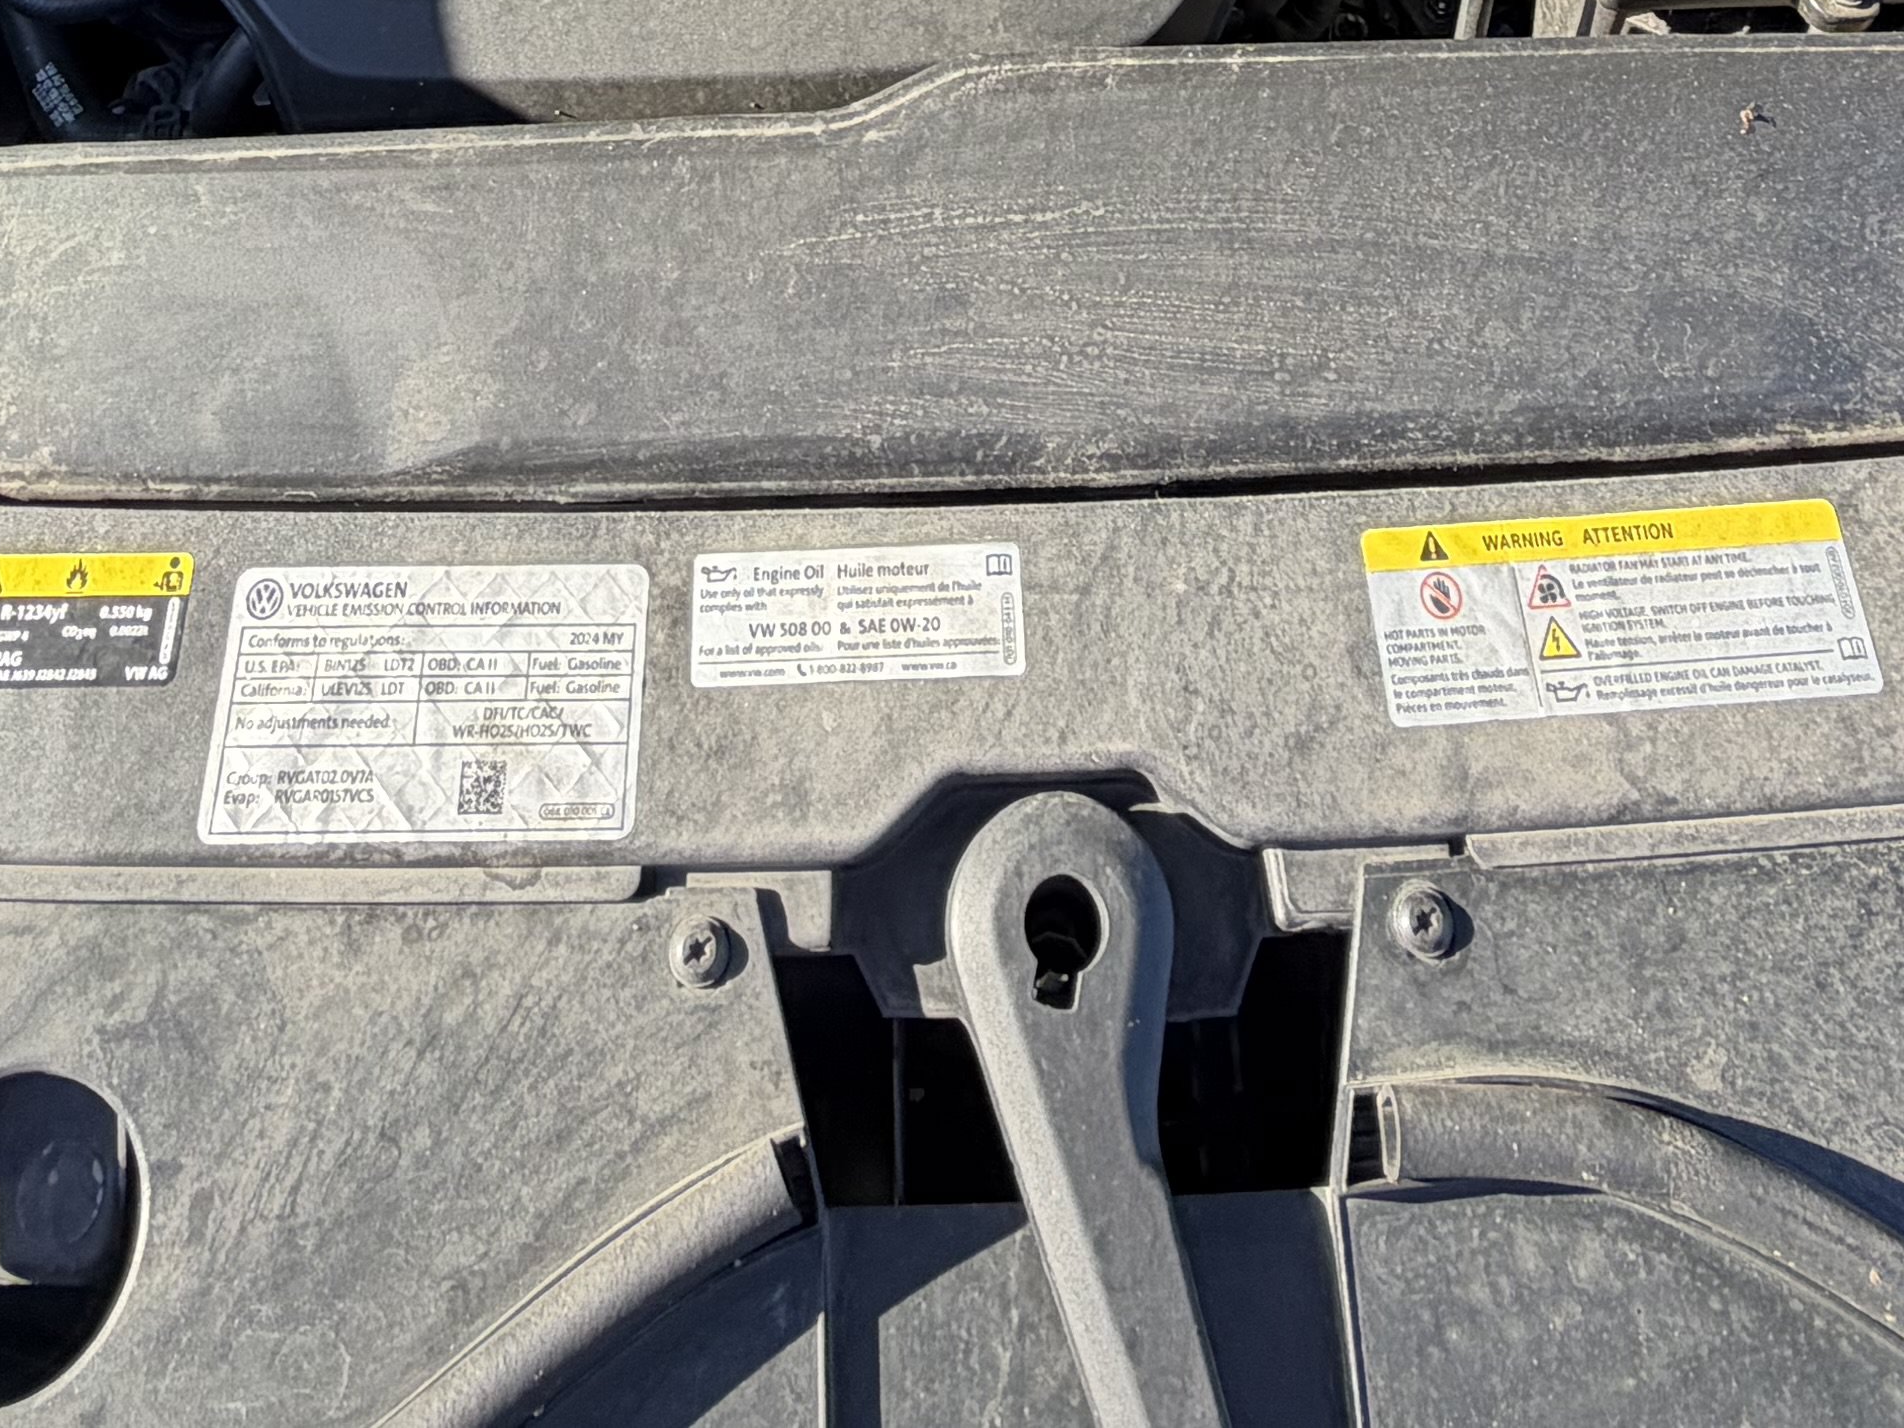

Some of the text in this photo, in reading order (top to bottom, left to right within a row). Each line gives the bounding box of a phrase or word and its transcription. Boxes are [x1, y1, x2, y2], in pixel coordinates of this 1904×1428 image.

[1482, 522, 1674, 551] WARNING ATTENTION
[837, 562, 929, 579] Huile moteur
[1569, 555, 1724, 574] RADIATOR FAN MAY START AT ANY
[753, 564, 824, 584] Engine Oil
[1573, 563, 1821, 590] Le ventilateur de radiateur peut tout
[289, 581, 408, 599] VOLKSWAGEN
[700, 584, 824, 601] Use only oil that expressly
[837, 585, 873, 596] Utilisez
[876, 582, 935, 596] uniquement
[937, 582, 950, 592] de
[287, 601, 562, 617] VEHICLE EMISSION CONTROL INFORMATION
[700, 601, 767, 615] complies with
[837, 599, 852, 612] qui
[855, 597, 894, 609] satisfait
[1579, 593, 1835, 620] HIGH SWITCH OFF ENGINE BEFORE TOUCHING
[0, 603, 154, 624] R-1234yf 0.550 kg
[749, 616, 941, 639] VW 508 00 & SAE 0W-20
[1384, 624, 1486, 640] HOT PARTS IN MOTOR
[1581, 620, 1625, 633] IGNITION
[248, 632, 624, 651] Conforms to regulations: 2024 MY
[1585, 637, 1615, 648] Haute
[1693, 631, 1703, 640] le
[1704, 629, 1739, 639] moteur
[1743, 627, 1770, 638] avant
[1772, 626, 1785, 635] de
[1786, 622, 1823, 634] toucher
[698, 642, 801, 657] For a list of approved
[837, 640, 859, 651] Pour
[862, 640, 880, 650] une
[882, 638, 901, 649] liste
[245, 658, 300, 673] U.S. EPA:
[324, 657, 415, 672] BIN125 LDT2
[427, 657, 460, 672] OBD:
[466, 657, 485, 671] CA
[531, 655, 622, 671] Fuel: Gasoline
[1389, 655, 1428, 667] MOVING
[124, 666, 169, 681] VW AG
[1391, 667, 1529, 686] Composants très chauds dans
[1593, 662, 1773, 687] OVERFILLED ENGINE OIL CAN DAMAGE
[241, 678, 307, 697] California:
[321, 681, 405, 697] ULEV125 LDT
[424, 680, 458, 695] OBD:
[464, 680, 483, 694] CA
[530, 679, 621, 694] Fuel: Gasoline
[1393, 689, 1403, 699] le
[1596, 687, 1658, 700] Remplissage
[1660, 684, 1698, 697] excessif
[1735, 679, 1784, 693] dangereux
[1787, 677, 1809, 689] pour
[1812, 676, 1820, 686] le
[1396, 701, 1442, 714] Pièces en
[235, 718, 254, 730] No
[257, 715, 338, 734] adjustments
[226, 771, 272, 789] Group:
[223, 790, 260, 808] Evap:
